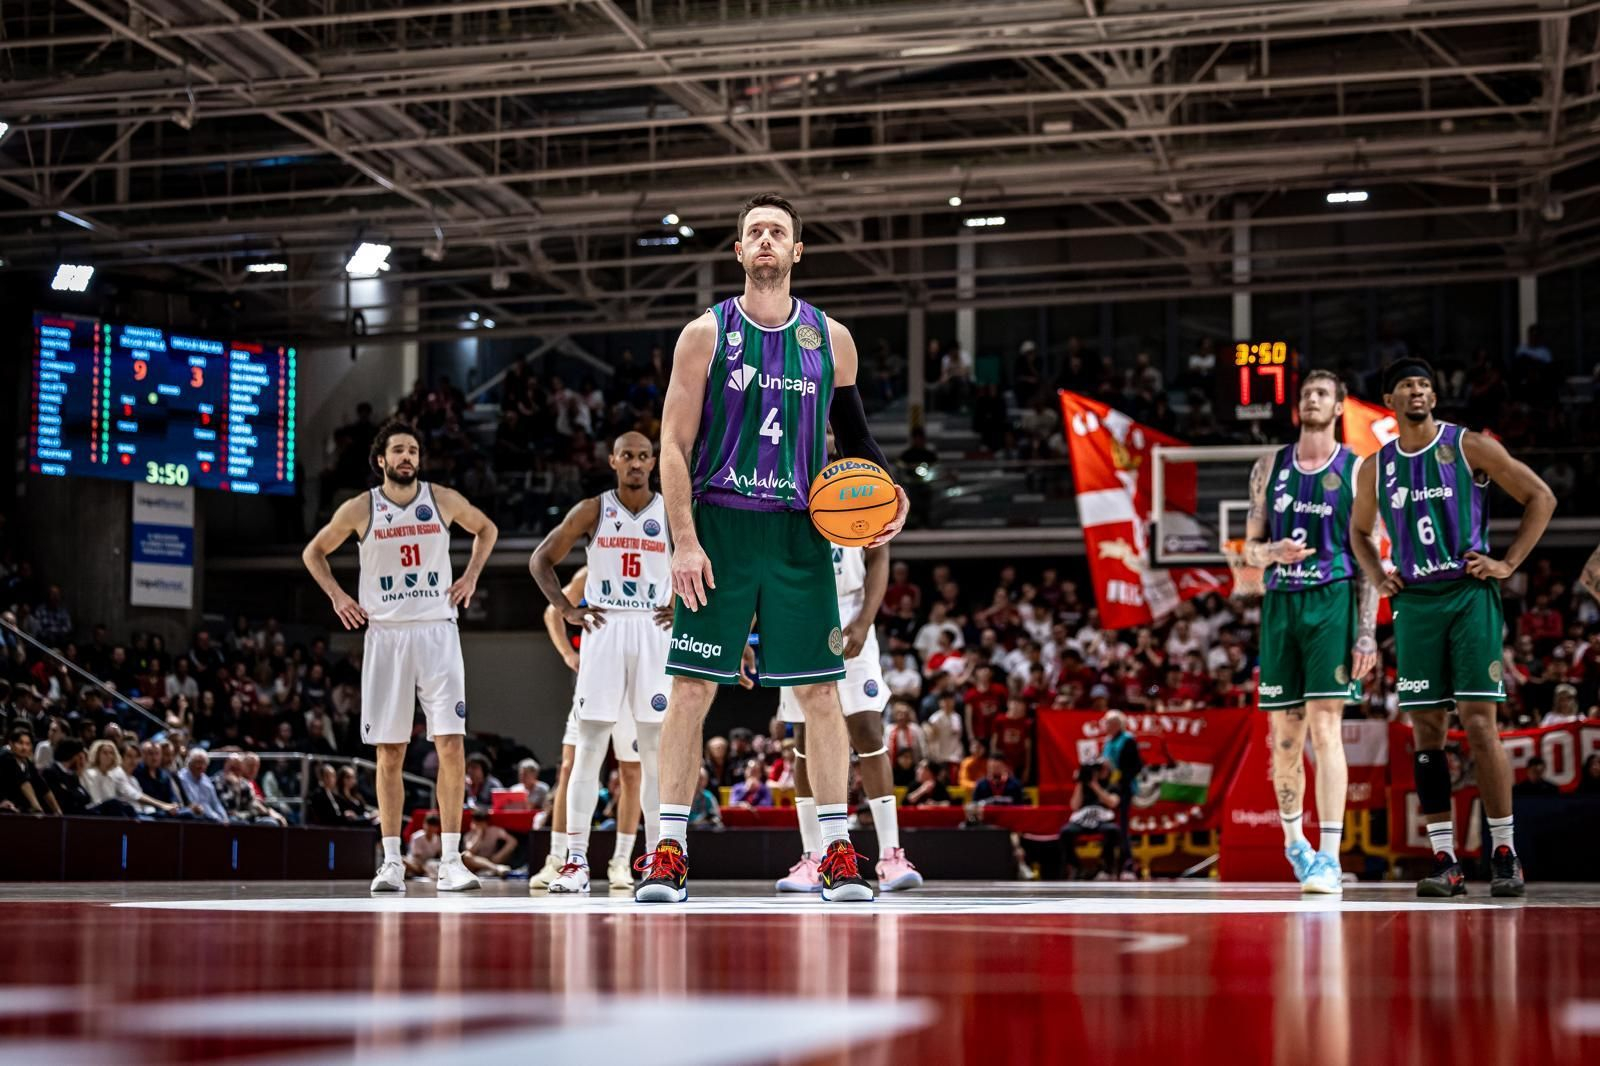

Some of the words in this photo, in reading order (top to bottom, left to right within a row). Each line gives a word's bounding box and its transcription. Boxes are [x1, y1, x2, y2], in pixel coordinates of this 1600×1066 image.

[1235, 342, 1287, 366] 3:50
[133, 360, 148, 381] 9
[190, 366, 204, 388] 3
[758, 373, 816, 396] Unicaja
[1239, 365, 1285, 406] 17
[759, 407, 783, 445] 4
[146, 461, 189, 487] 3:50
[822, 461, 882, 480] Wilson
[1417, 515, 1436, 545] 6
[400, 544, 421, 568] 31
[621, 553, 641, 578] 15
[381, 590, 440, 603] UNAHOTELS
